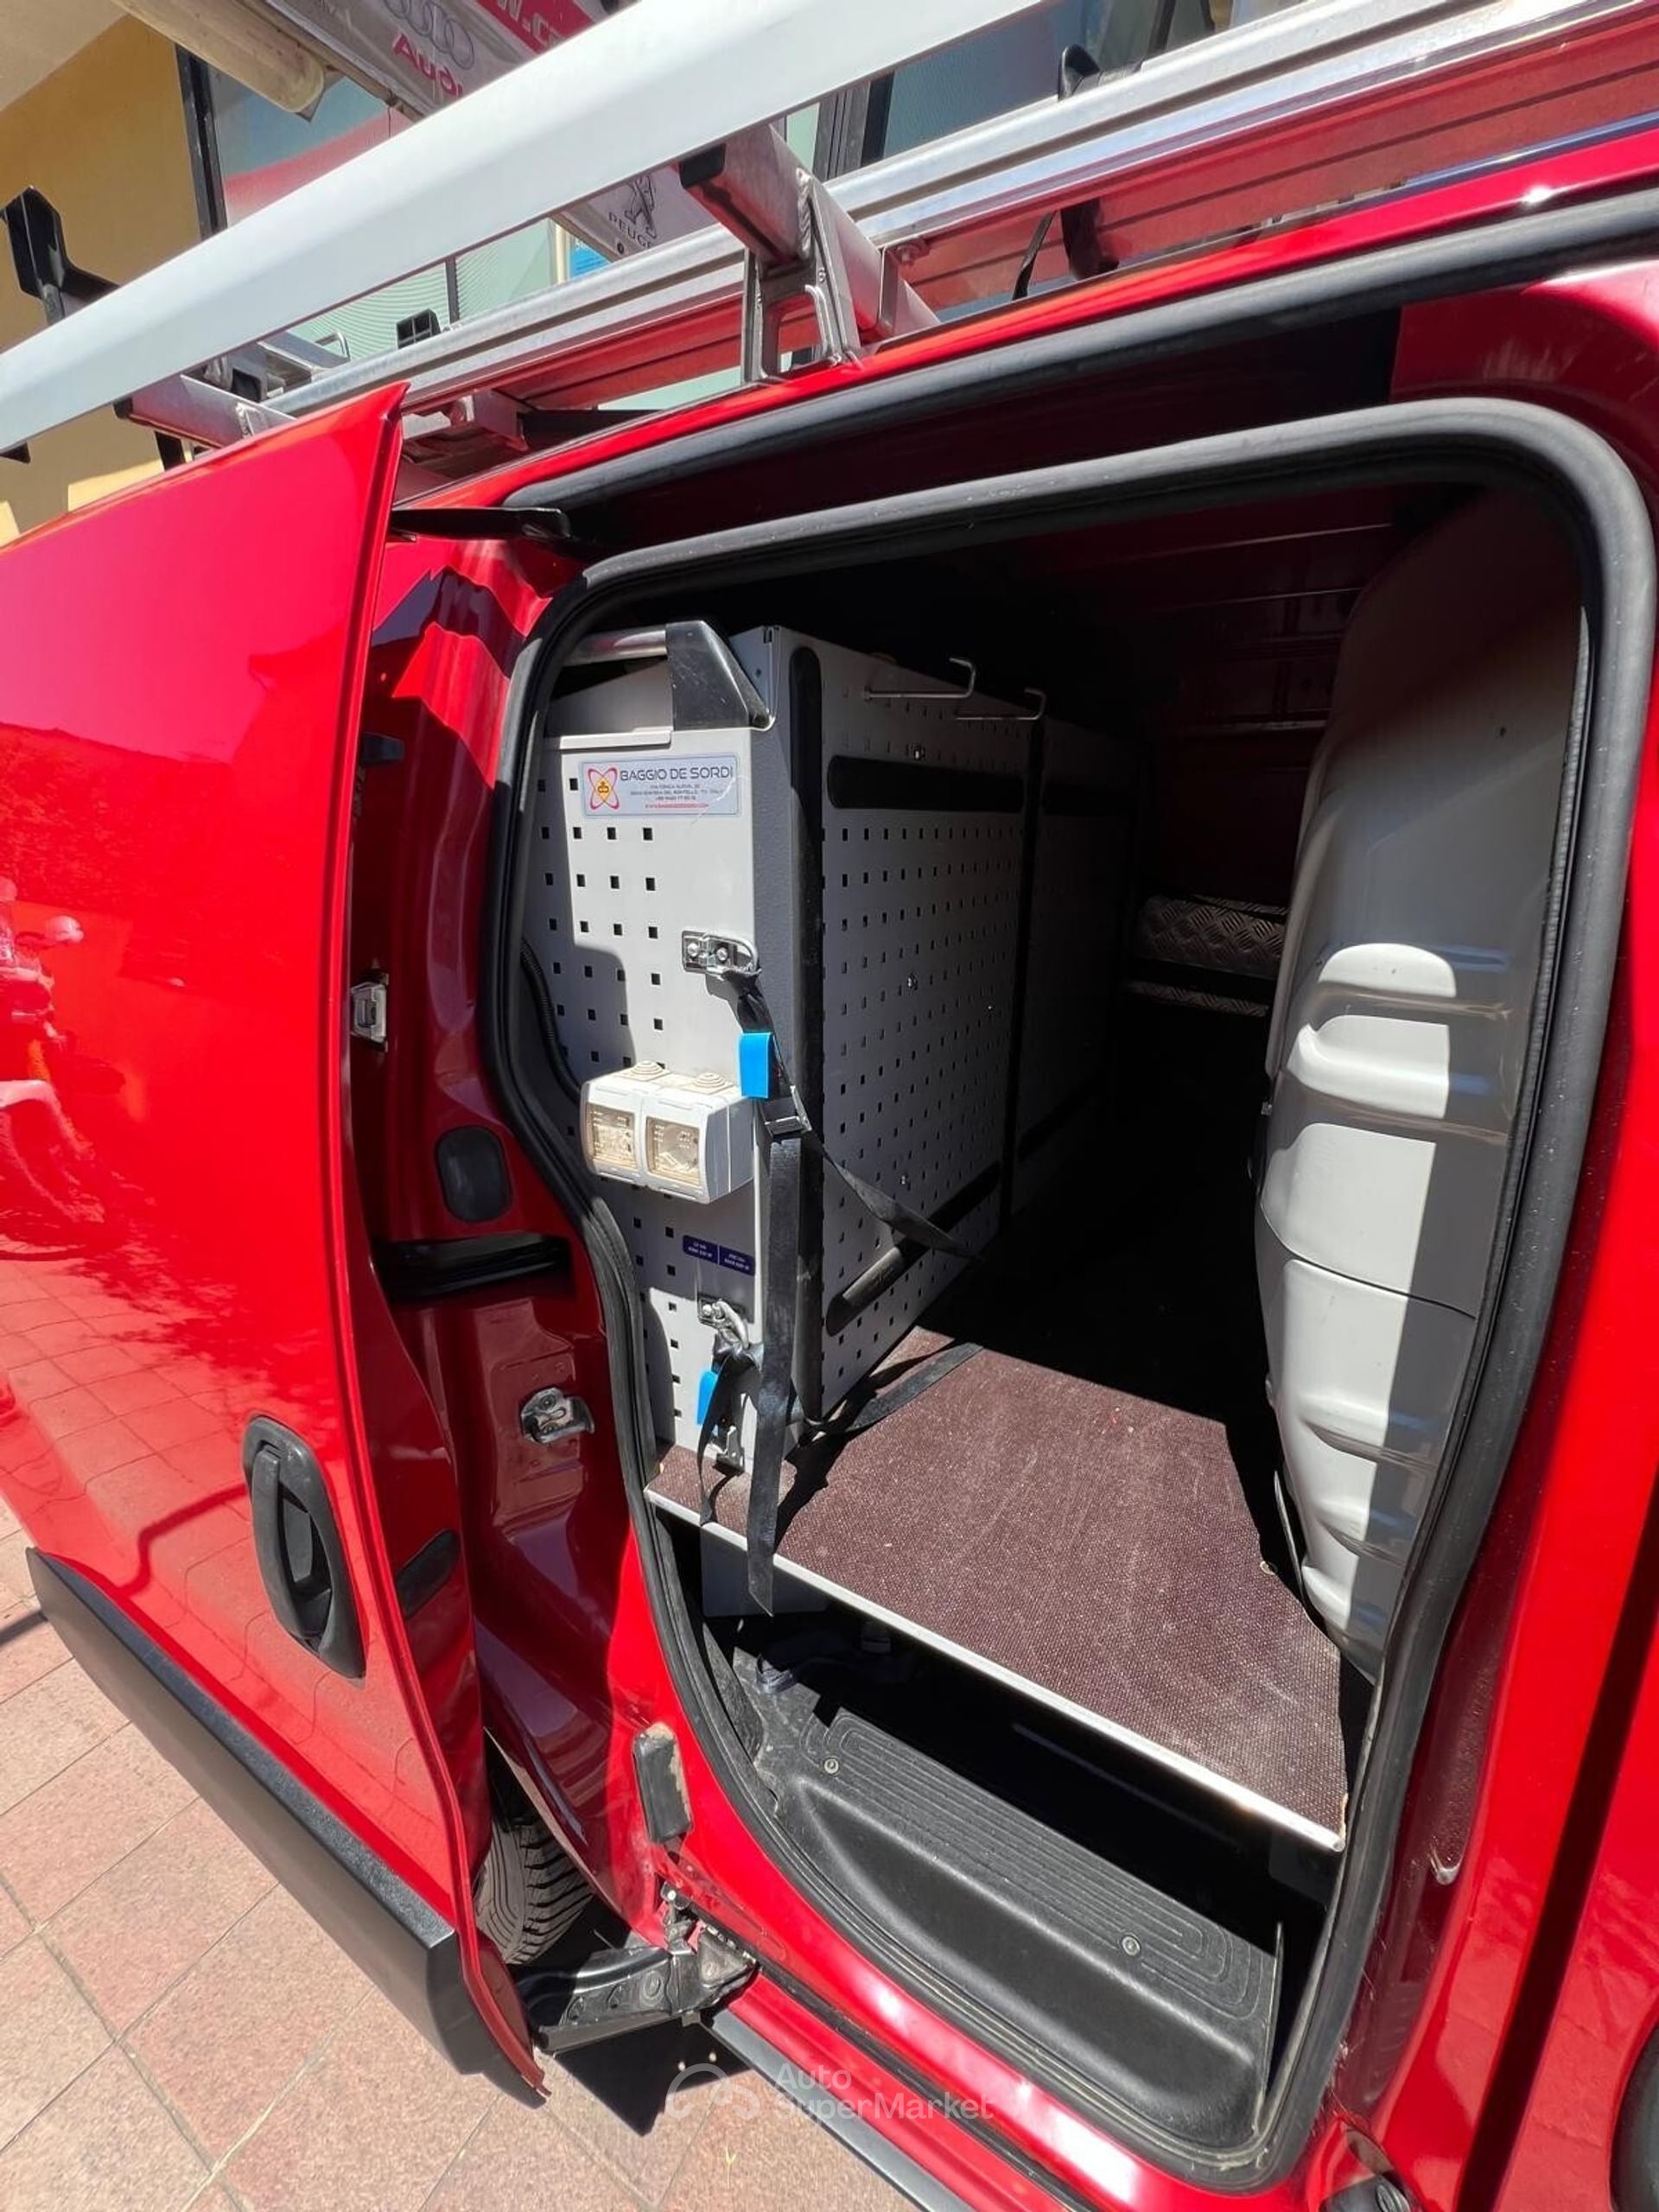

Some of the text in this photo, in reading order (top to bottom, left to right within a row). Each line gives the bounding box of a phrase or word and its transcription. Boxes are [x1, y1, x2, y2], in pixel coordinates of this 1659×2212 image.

[620, 766, 734, 781] BAGGIO DE SORDI
